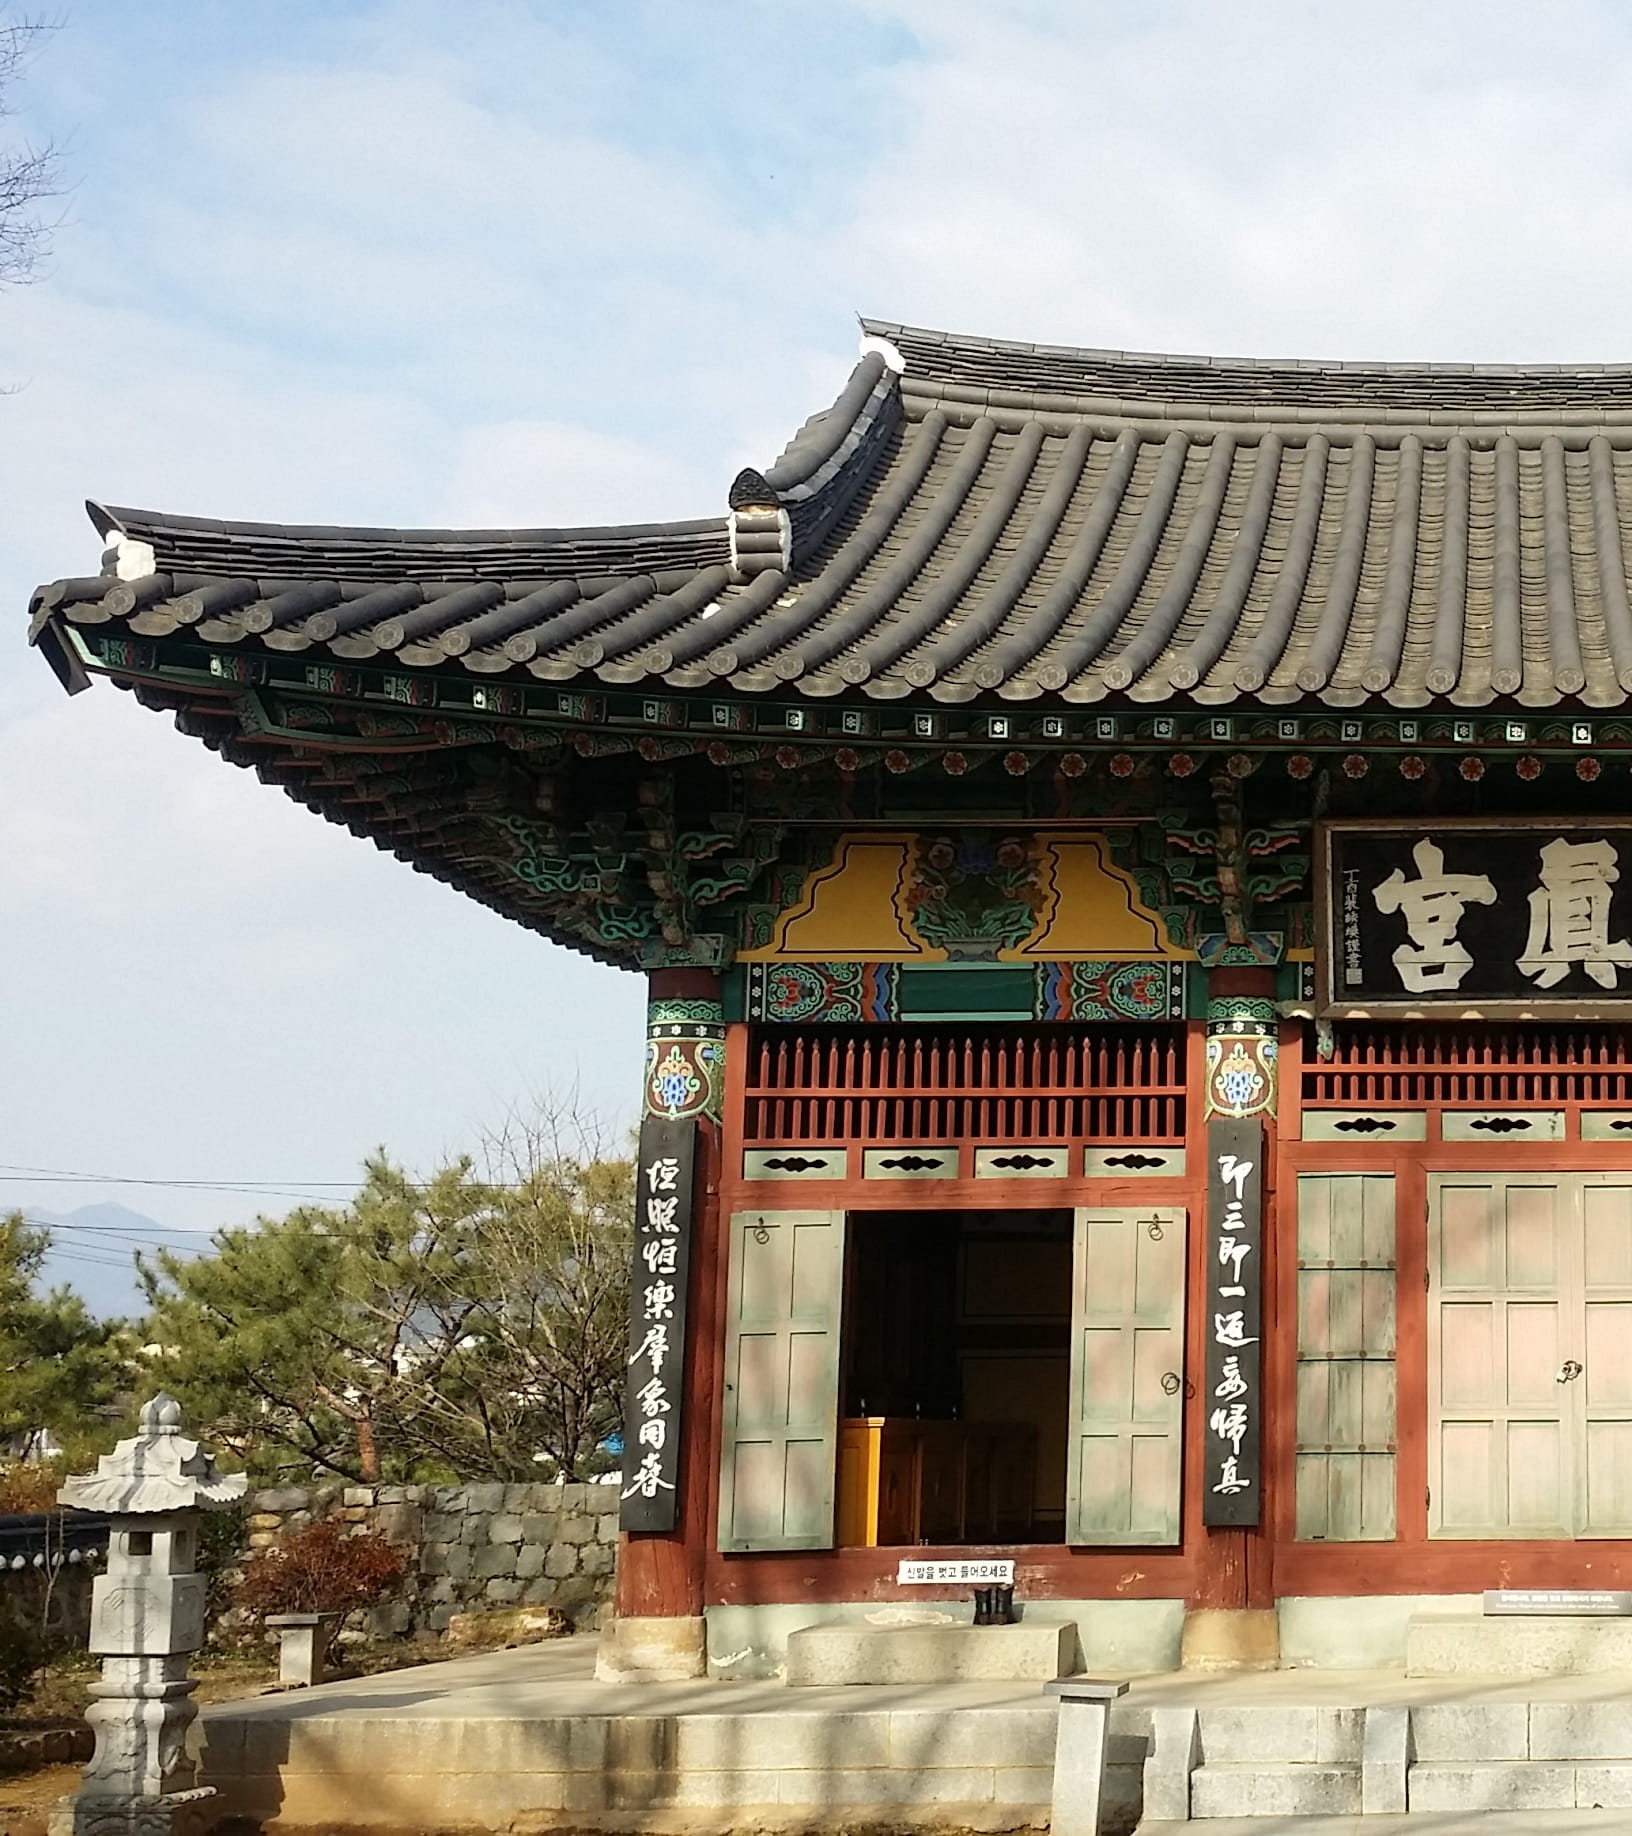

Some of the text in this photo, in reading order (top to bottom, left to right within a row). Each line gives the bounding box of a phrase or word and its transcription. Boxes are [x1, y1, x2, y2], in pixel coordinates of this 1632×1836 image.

[907, 1565, 1008, 1580] 신발을 벗고 들어오세요
